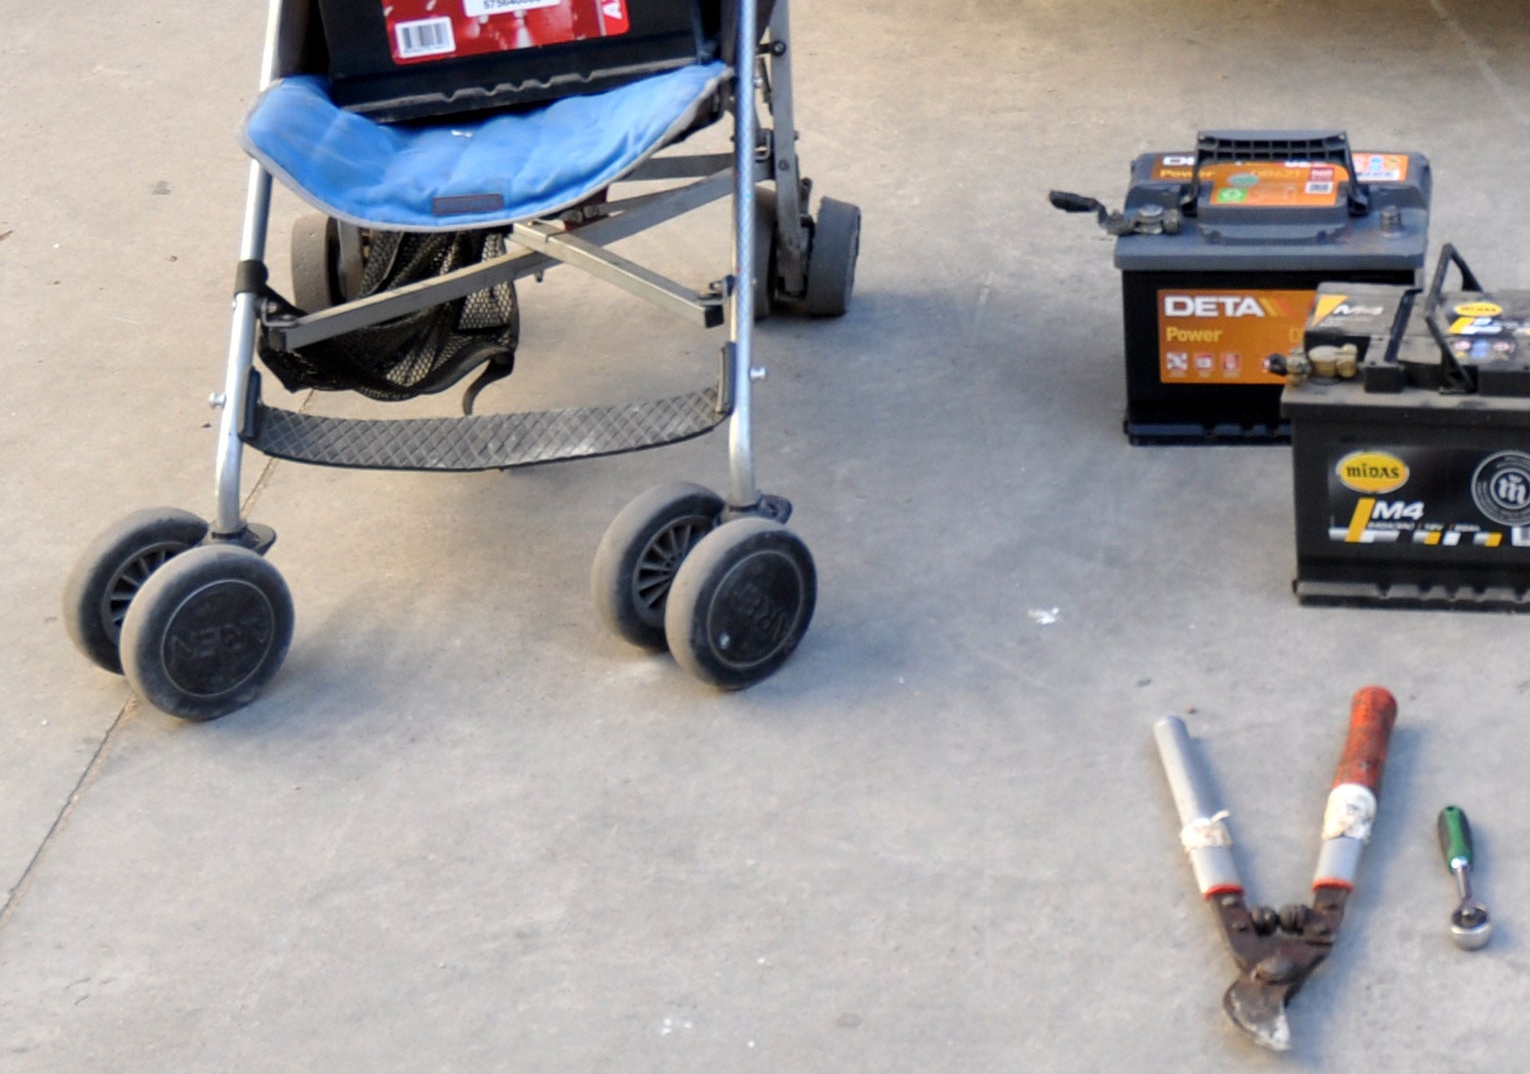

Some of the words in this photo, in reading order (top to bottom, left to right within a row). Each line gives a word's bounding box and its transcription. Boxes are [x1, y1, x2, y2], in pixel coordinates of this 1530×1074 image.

[1164, 296, 1265, 317] DETA
[1165, 326, 1223, 343] Power
[1371, 500, 1425, 521] M4
